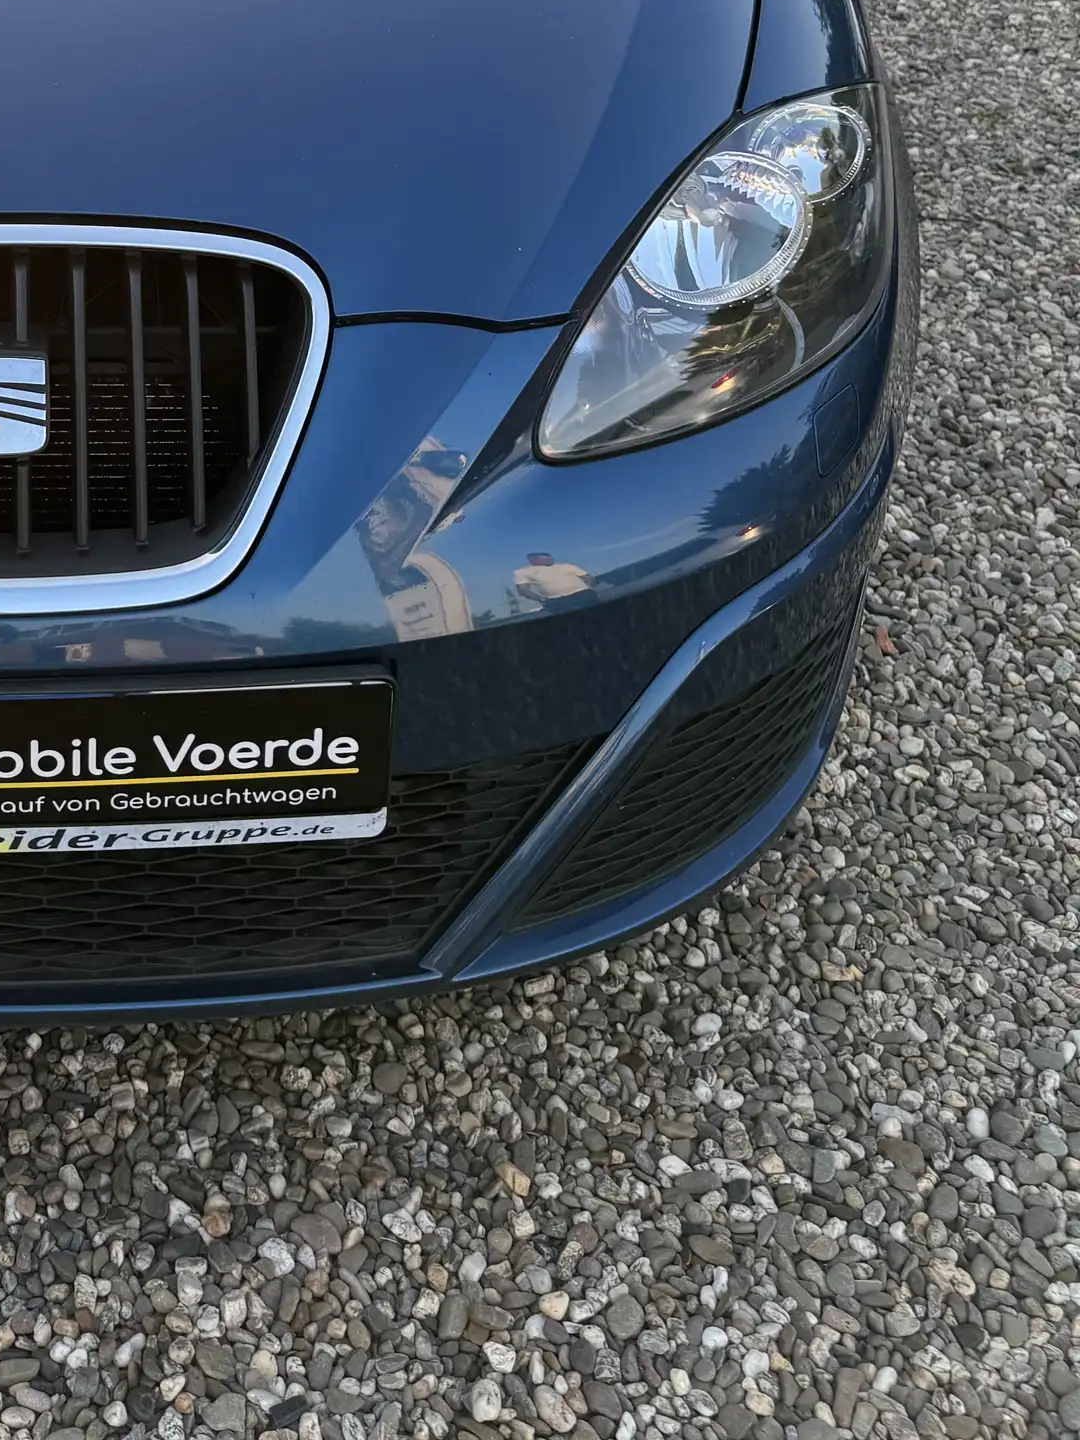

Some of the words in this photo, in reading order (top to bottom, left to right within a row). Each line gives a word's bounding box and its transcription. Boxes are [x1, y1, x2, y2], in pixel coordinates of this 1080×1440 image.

[153, 727, 360, 773] Voerde
[52, 798, 100, 813] von
[110, 785, 337, 810] Gebrauchtwagen
